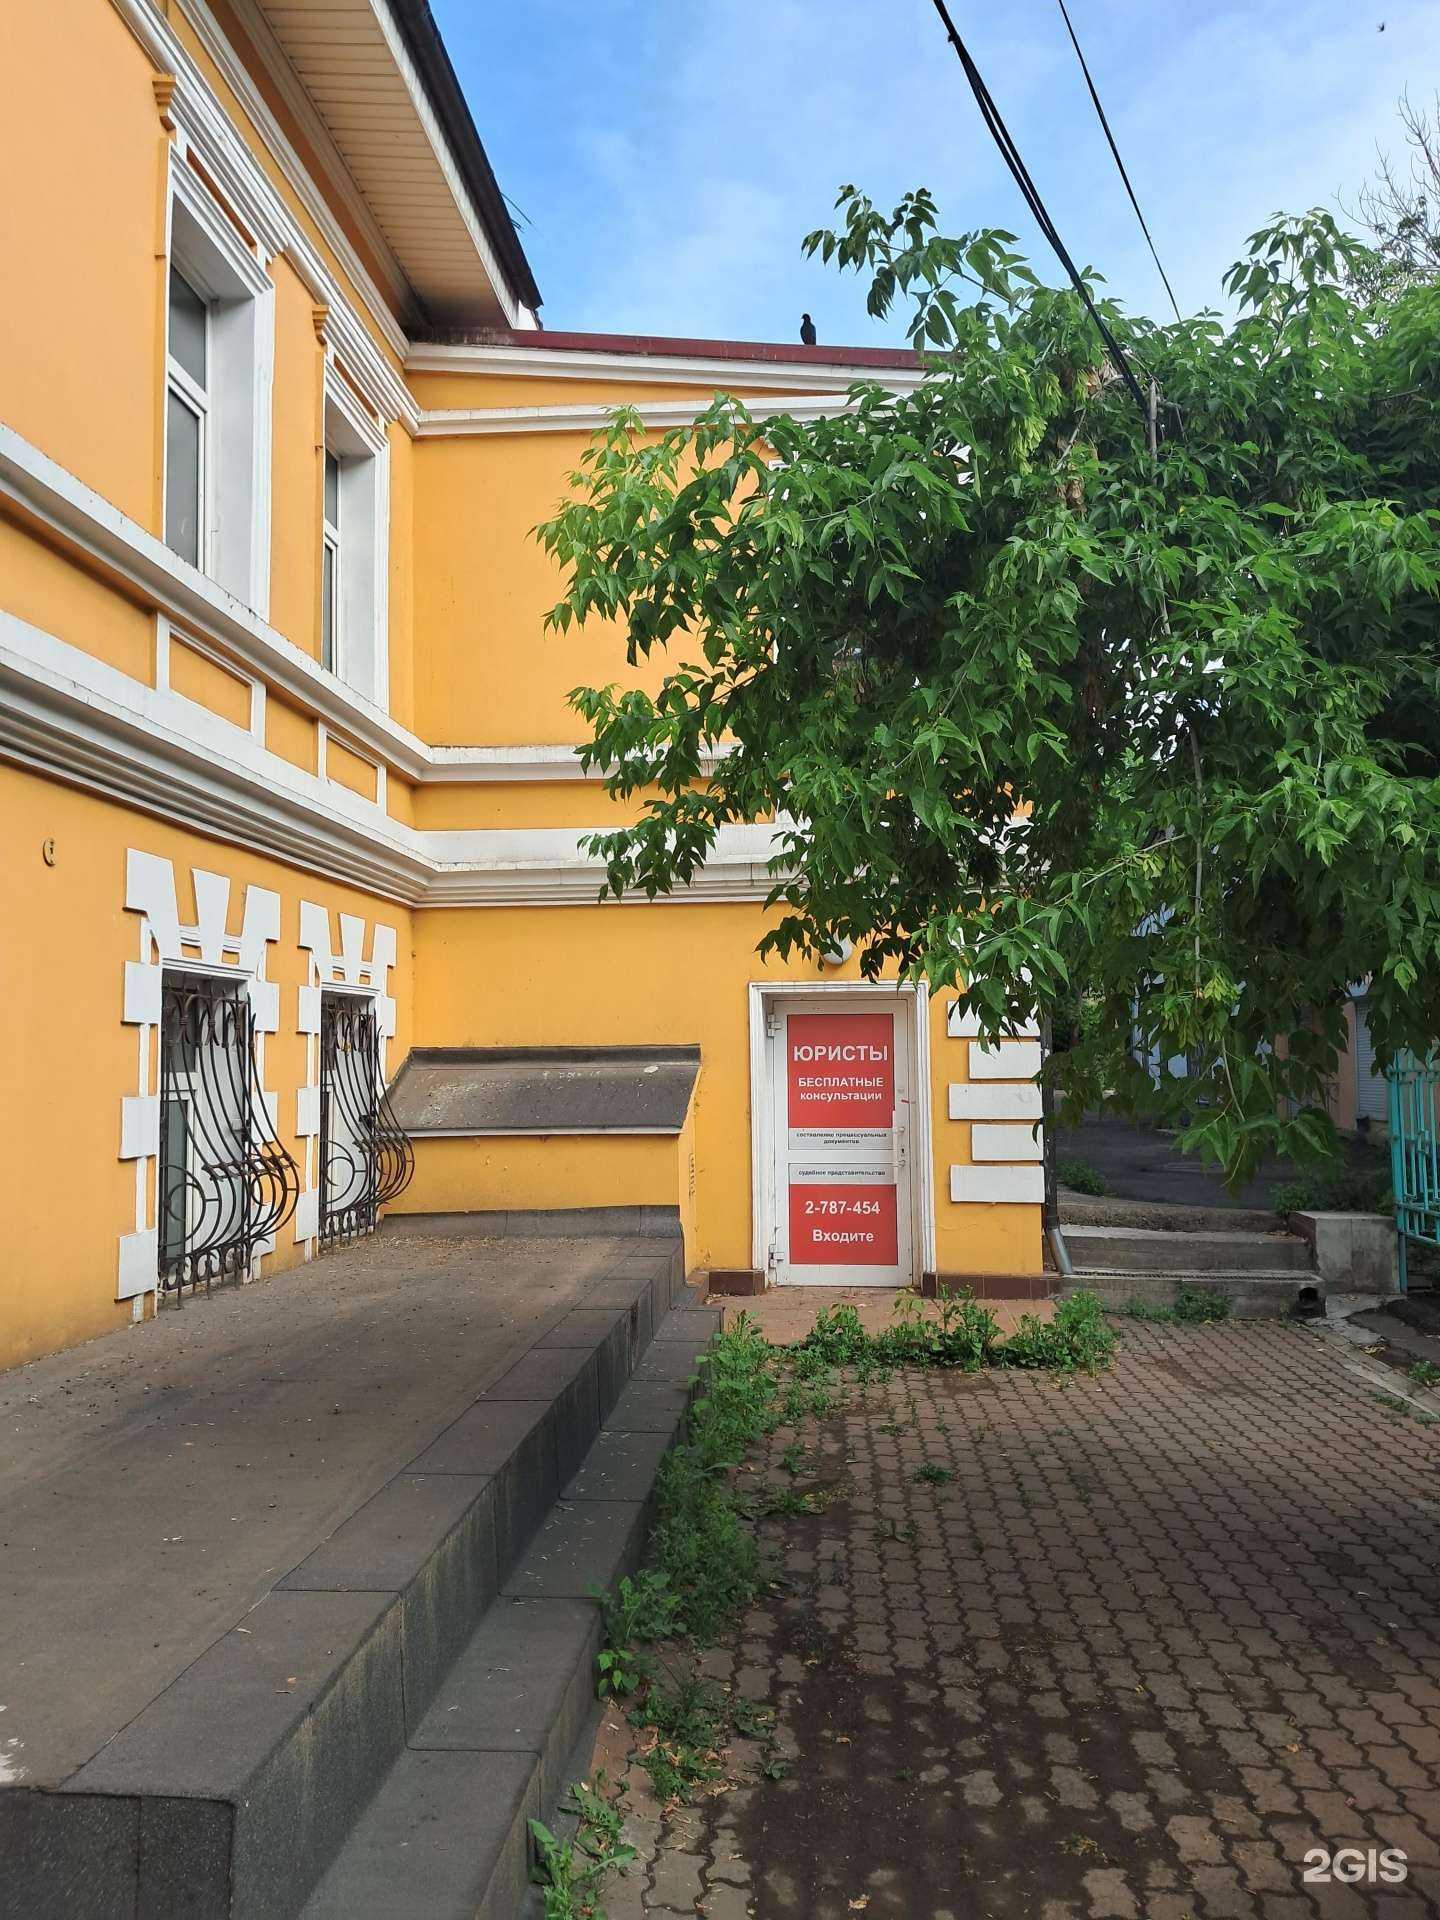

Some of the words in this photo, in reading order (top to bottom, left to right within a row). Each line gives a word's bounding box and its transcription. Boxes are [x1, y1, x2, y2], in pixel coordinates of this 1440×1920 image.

[793, 1045, 888, 1062] ЮРИСТЫ
[798, 1077, 884, 1087] БЕСПЛАТНЫЕ
[800, 1092, 882, 1102] консультации
[805, 1200, 881, 1215] 2-787-454
[812, 1229, 875, 1244] Входите
